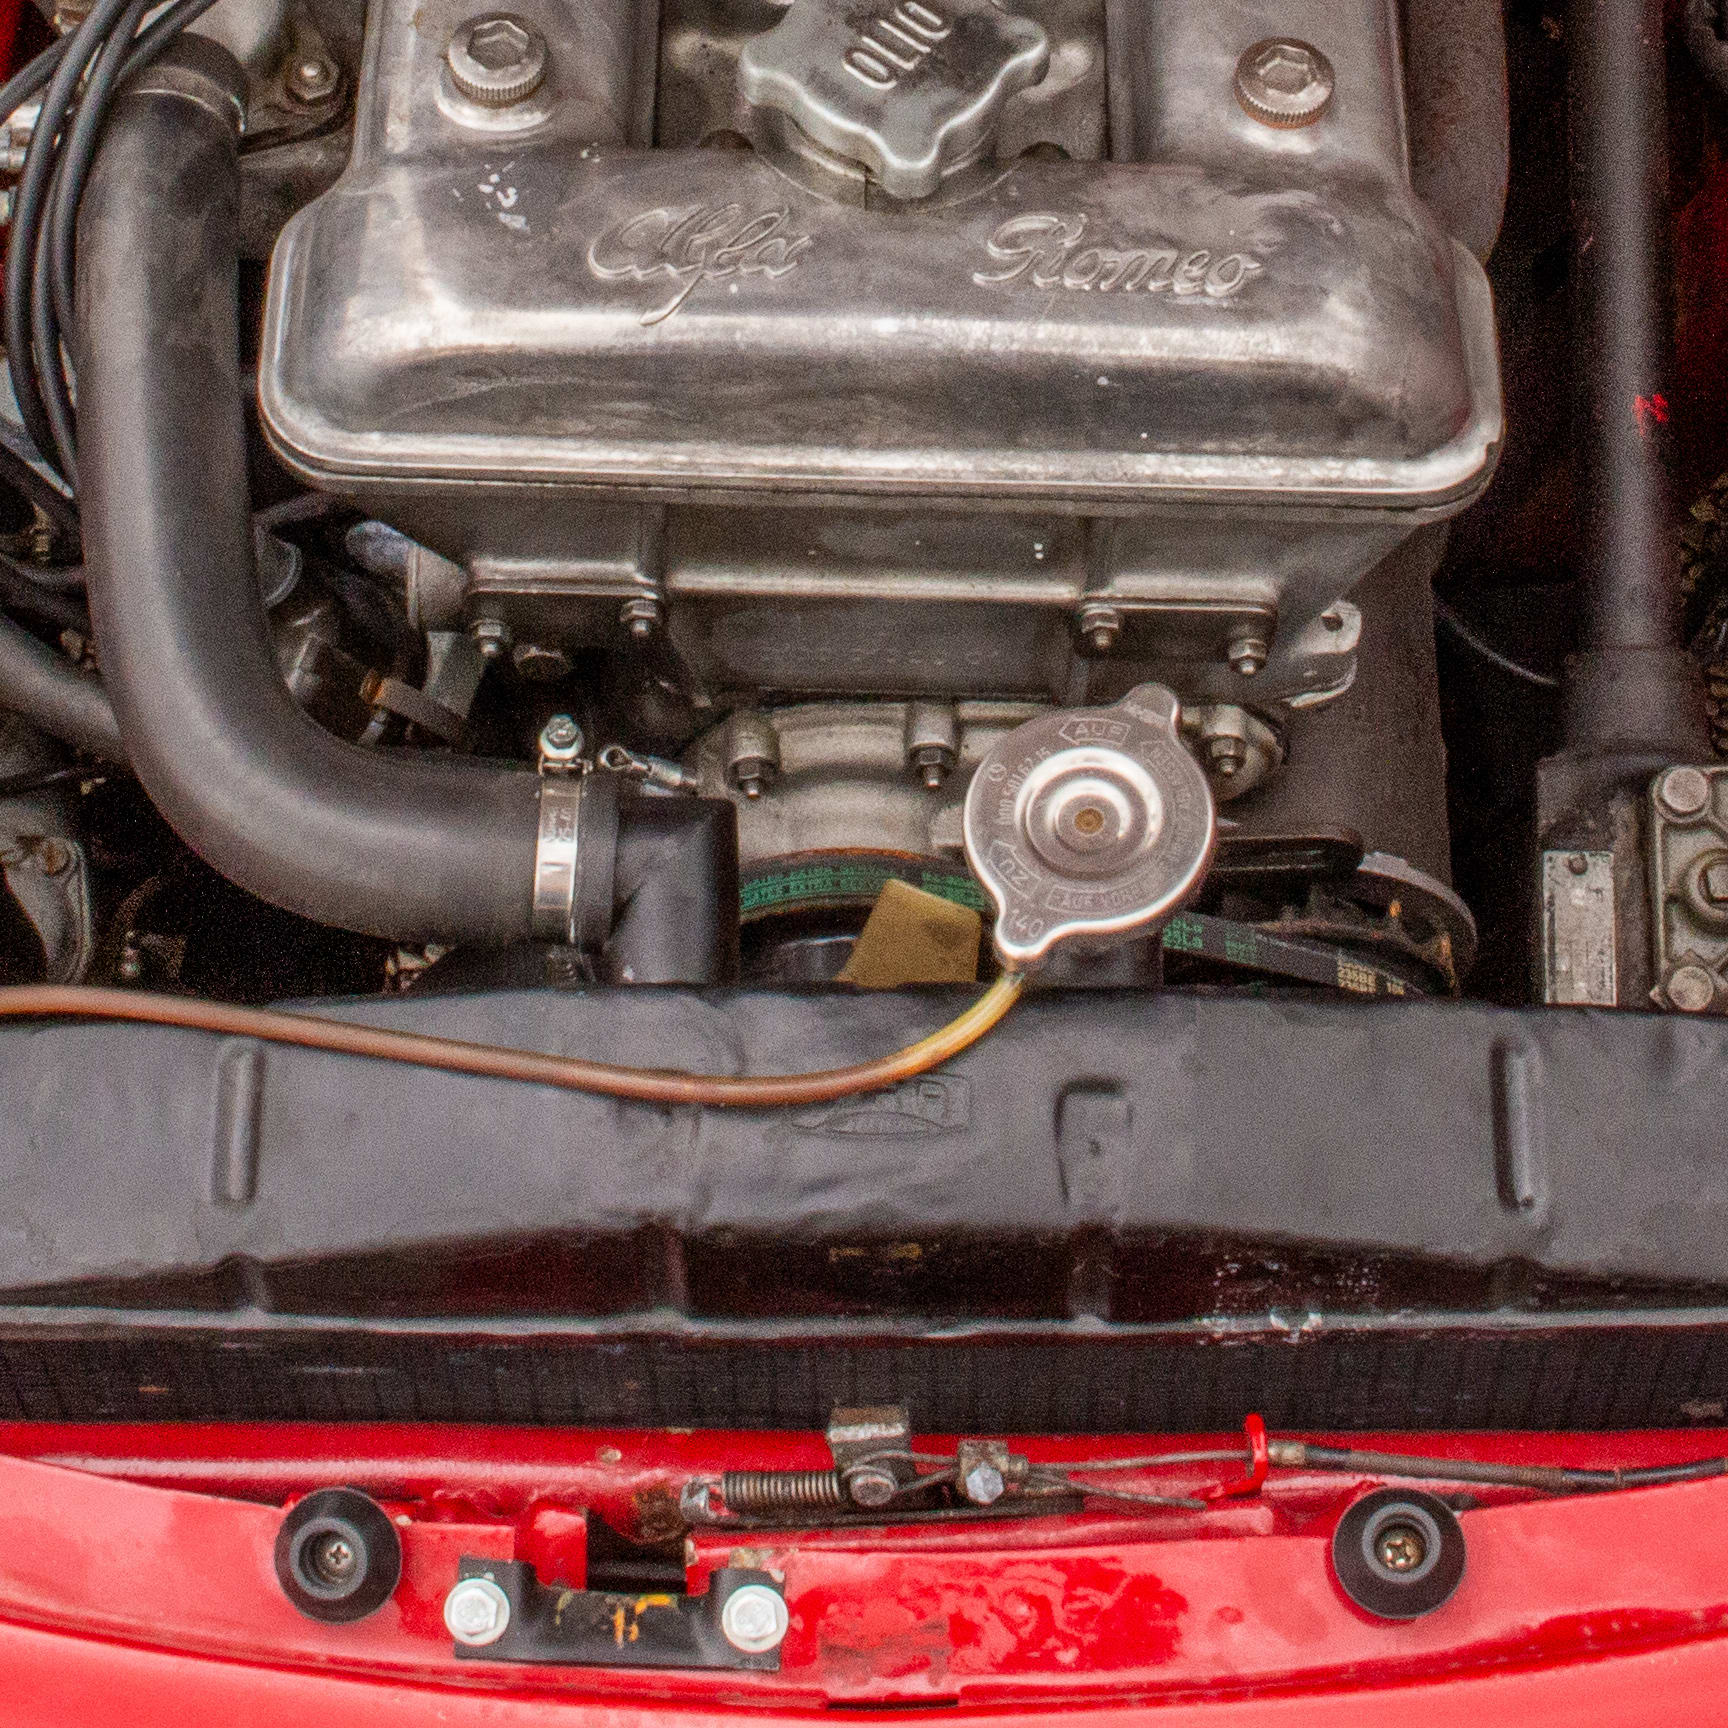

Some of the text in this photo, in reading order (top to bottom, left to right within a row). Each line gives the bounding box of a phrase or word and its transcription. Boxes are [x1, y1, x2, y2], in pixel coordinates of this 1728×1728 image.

[842, 1, 952, 91] OLIO
[586, 203, 1261, 327] Alfa Romeo
[1075, 722, 1123, 738] AUF
[997, 857, 1029, 887] ZU
